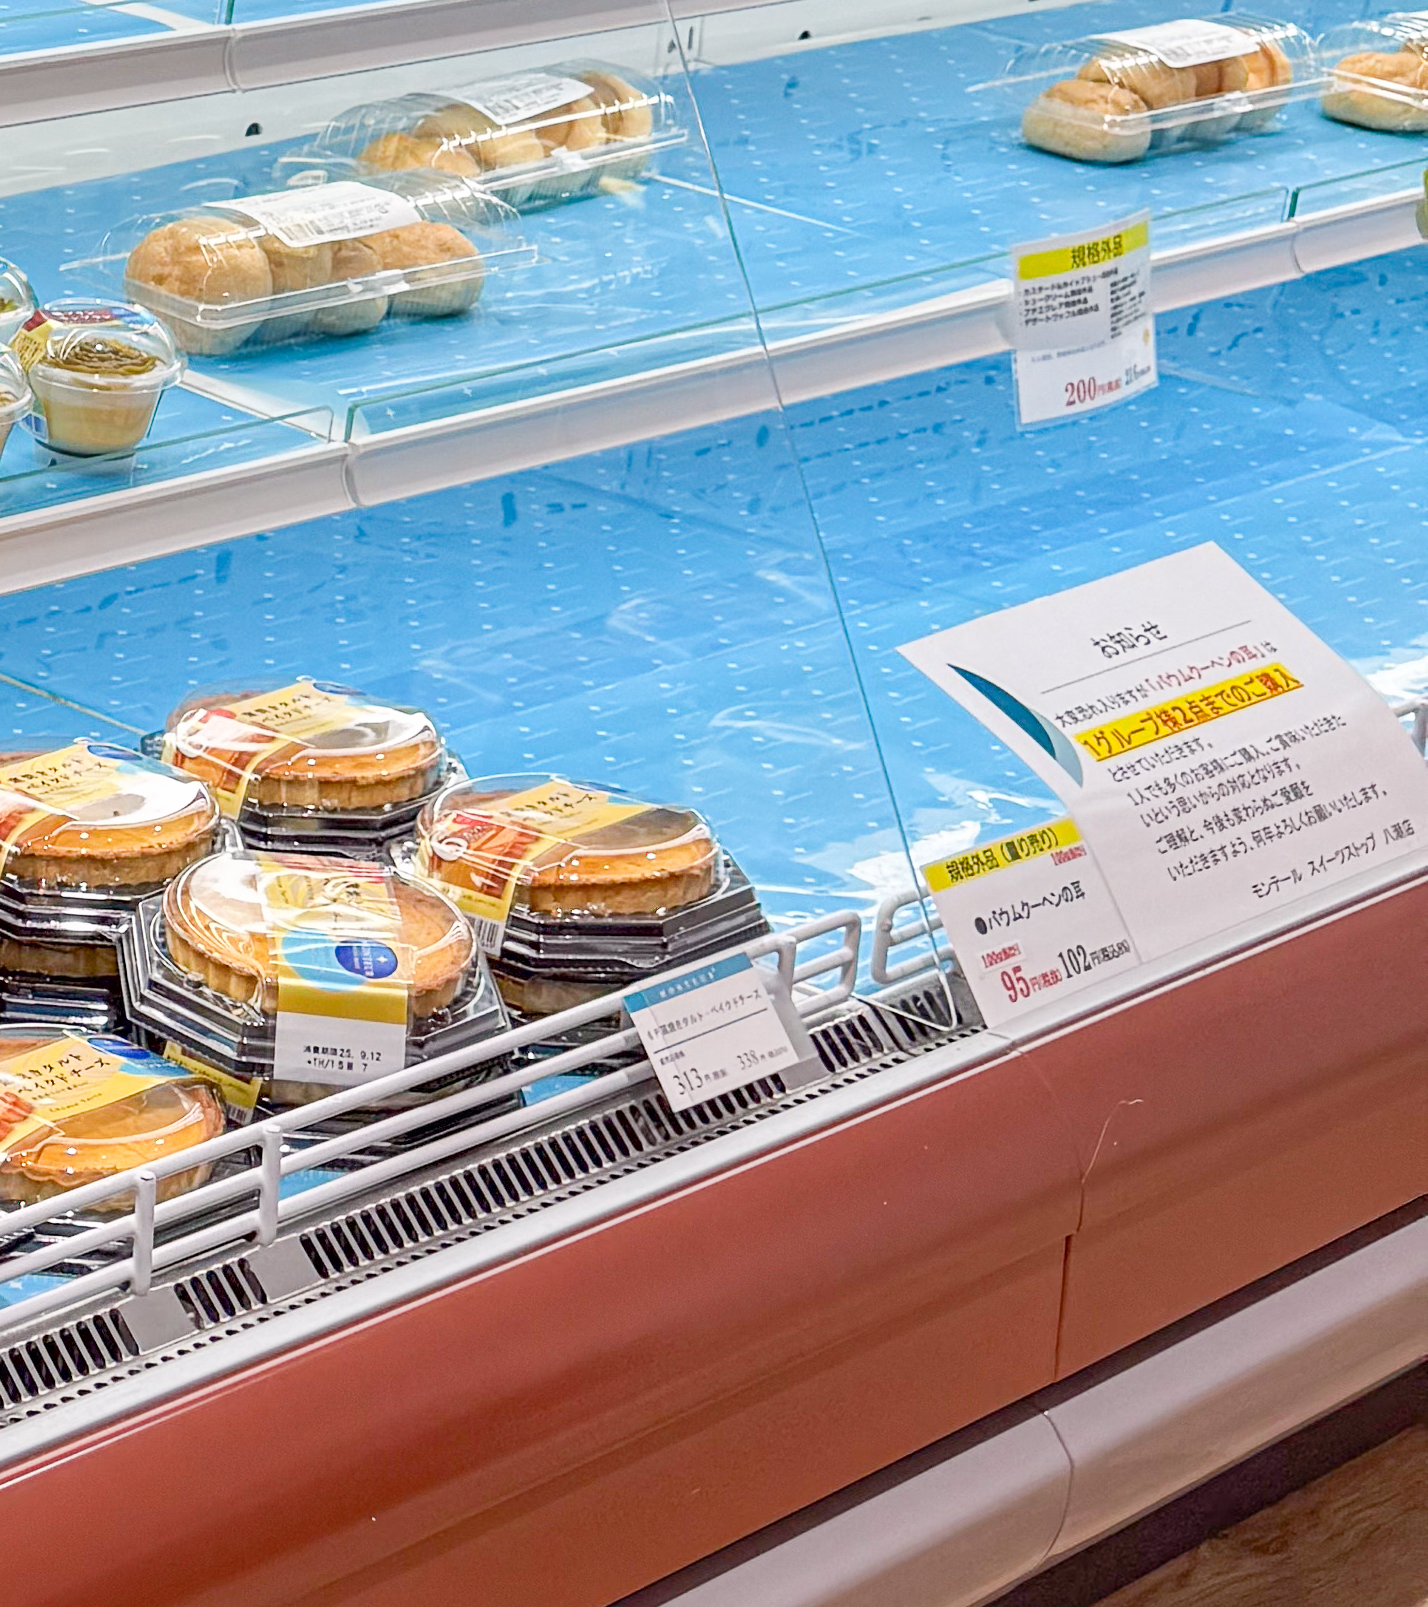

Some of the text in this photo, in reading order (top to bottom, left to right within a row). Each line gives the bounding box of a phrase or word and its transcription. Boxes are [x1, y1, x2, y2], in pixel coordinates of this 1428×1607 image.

[1064, 375, 1098, 408] 200
[1090, 620, 1168, 660] お知らせ
[1081, 667, 1301, 760] 1グループ様2点までのご購入
[1106, 737, 1215, 784] とさせていただきます。
[987, 880, 1087, 931] バウムクーヘンの耳
[736, 1049, 761, 1072] 338
